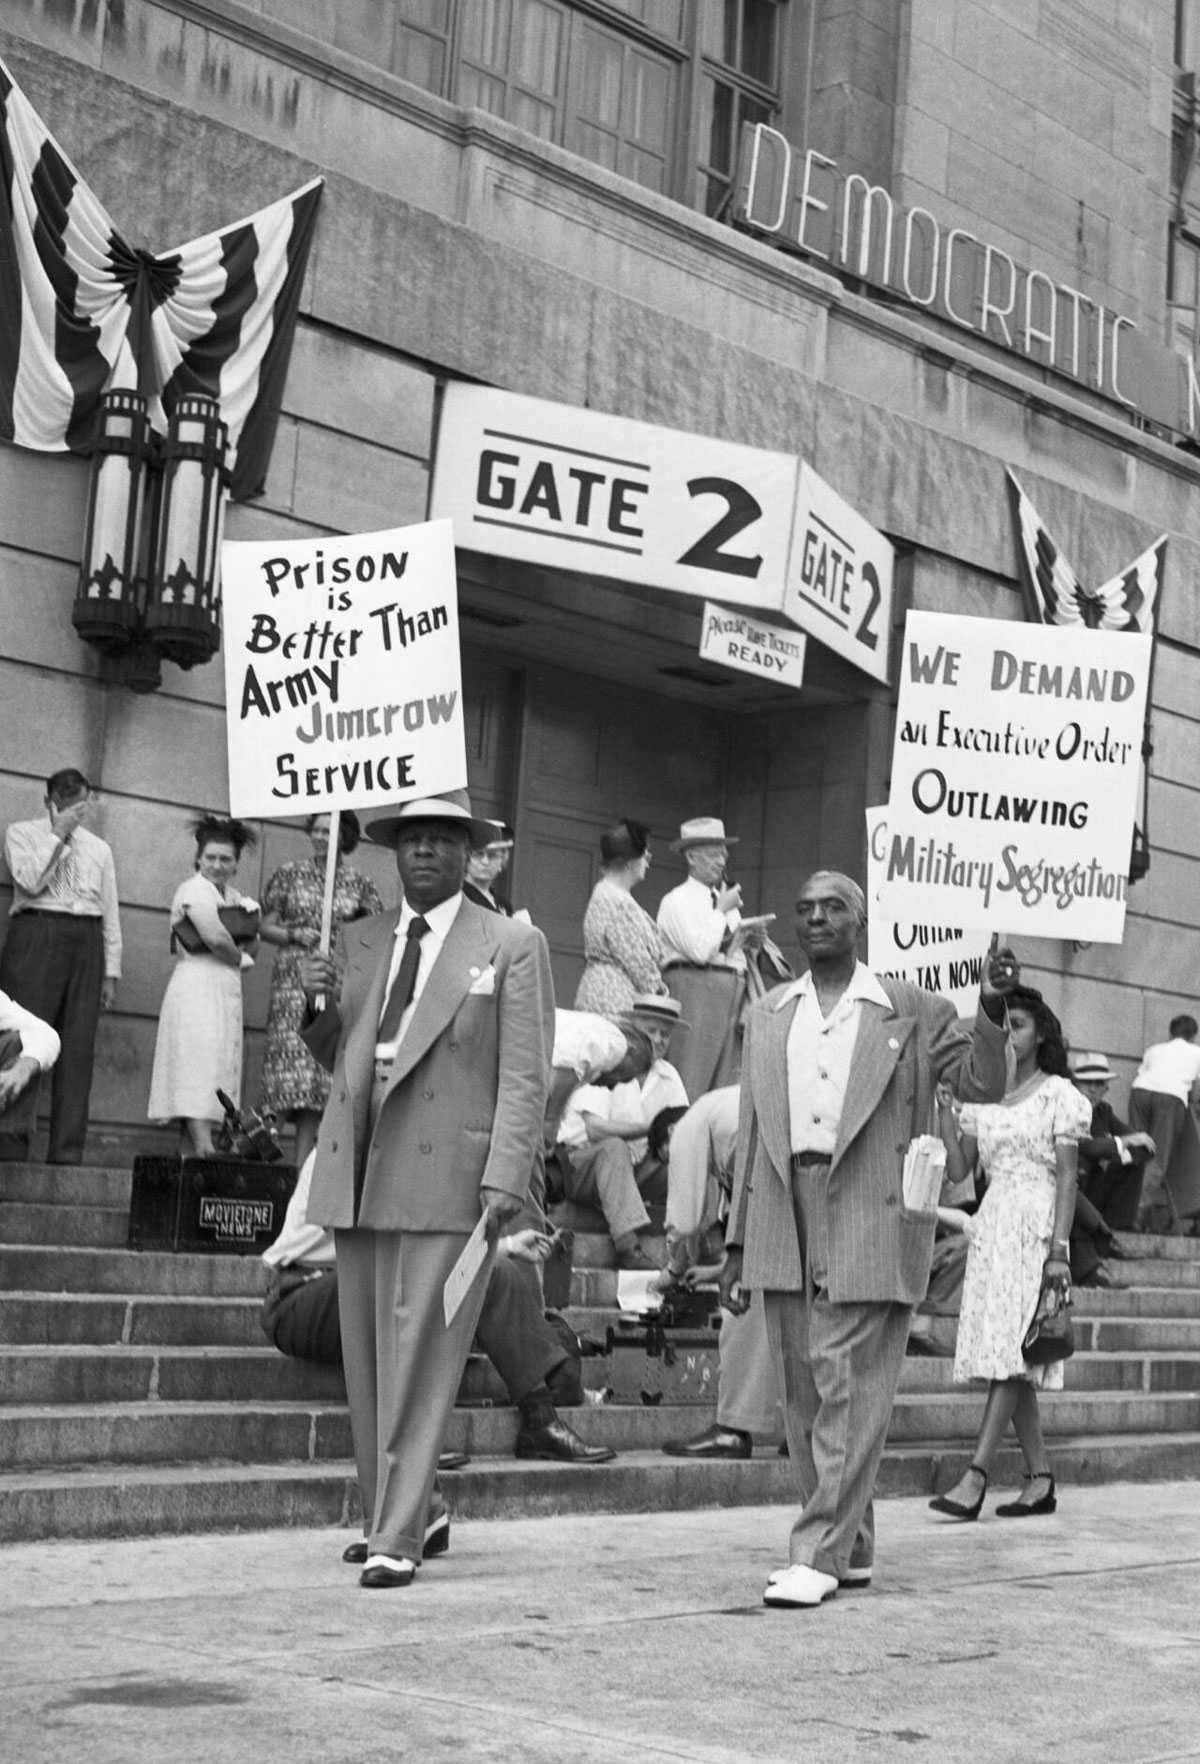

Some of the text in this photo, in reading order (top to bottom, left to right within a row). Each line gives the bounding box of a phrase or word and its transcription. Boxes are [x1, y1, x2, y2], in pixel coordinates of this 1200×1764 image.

[746, 122, 1137, 407] DEMOCRATIC
[476, 449, 764, 579] GATE 2
[327, 587, 353, 612] is
[801, 529, 882, 652] GATE 2
[245, 602, 449, 660] Better Than
[728, 641, 788, 672] READY
[240, 659, 340, 721] Army
[909, 642, 1136, 703] WE DEMAND
[900, 709, 1133, 766] an Executive Order
[886, 834, 994, 909] Military
[995, 844, 1128, 910] Segregation
[916, 955, 983, 993] TAX NOW
[204, 1202, 270, 1226] MOVIETONE
[220, 1221, 252, 1236] NEWS
